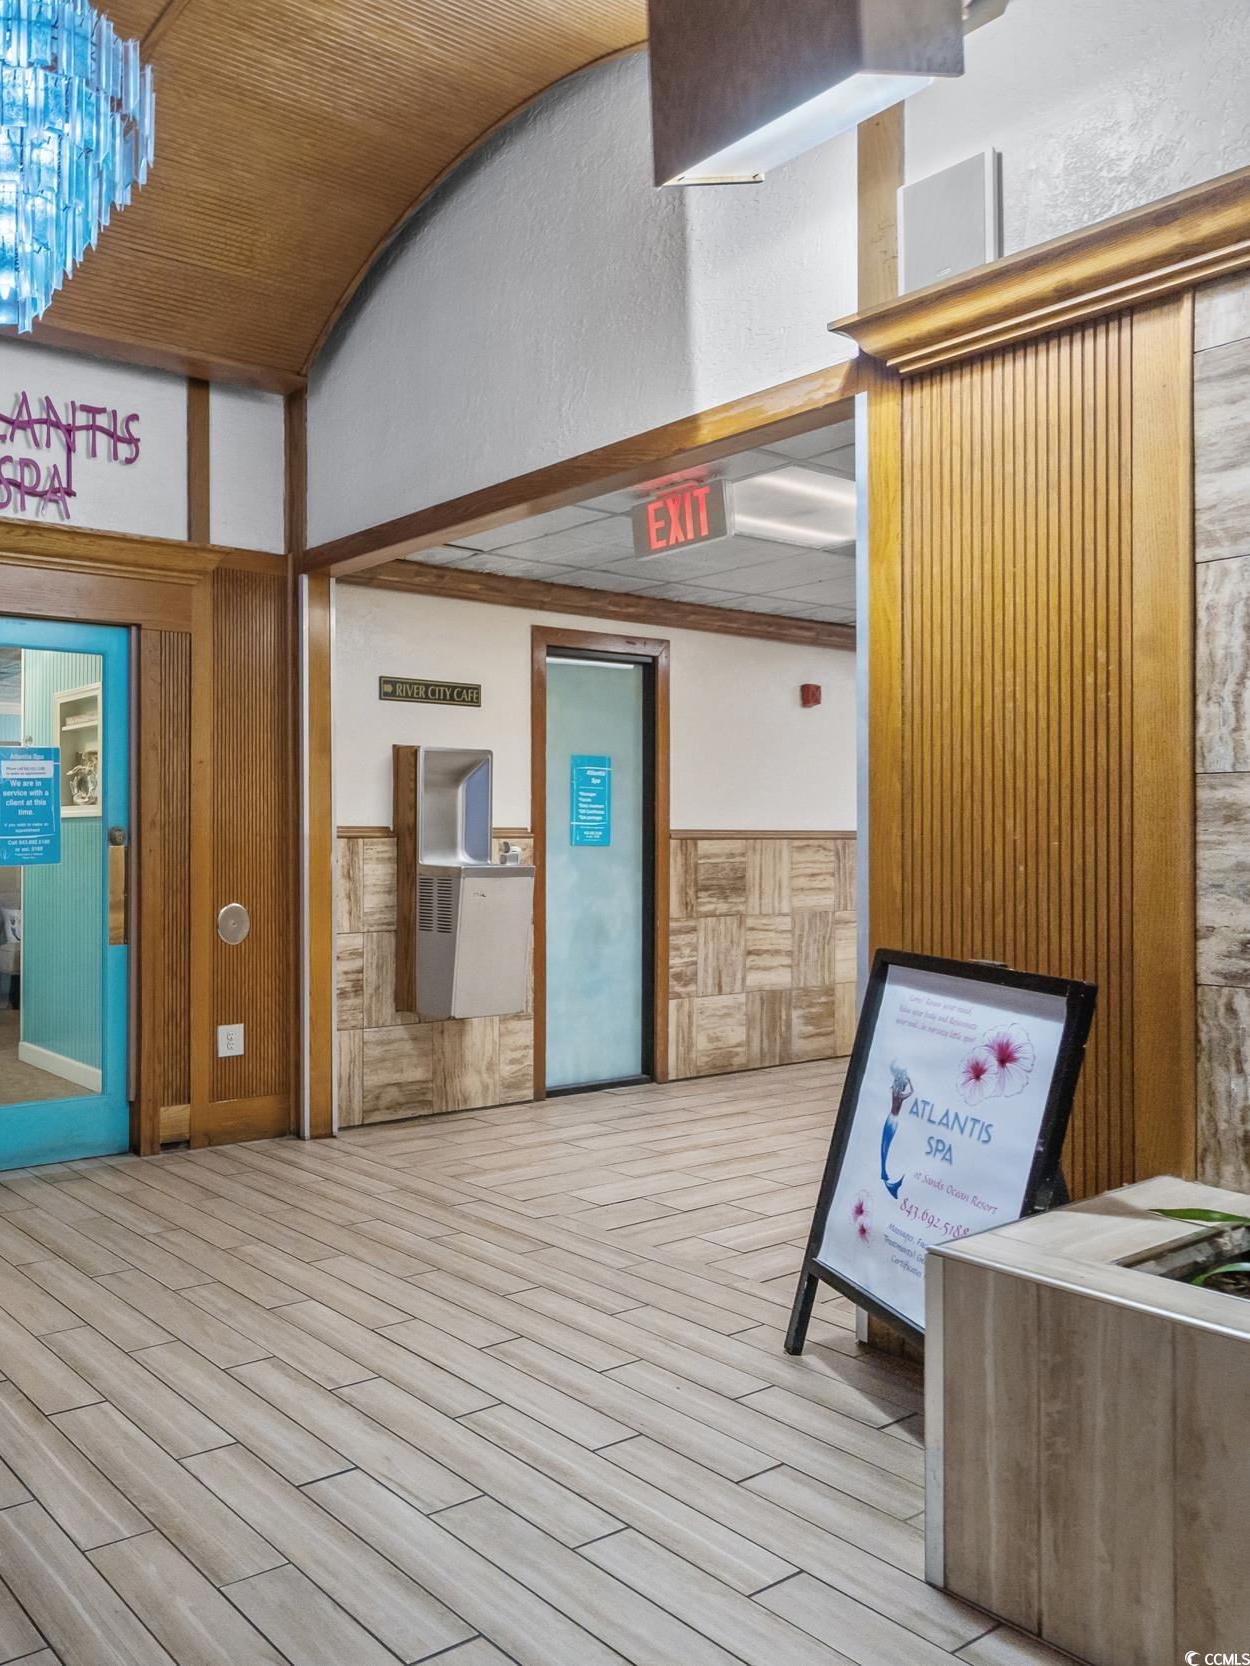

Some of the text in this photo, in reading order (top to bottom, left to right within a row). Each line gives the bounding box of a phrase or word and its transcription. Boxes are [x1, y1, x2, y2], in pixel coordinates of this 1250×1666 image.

[647, 486, 711, 550] EXIT
[396, 684, 479, 702] RIVER CITY CAFE
[909, 1097, 994, 1144] ATLANTIS
[925, 1136, 953, 1165] SPA
[922, 1174, 945, 1191] Sands
[946, 1184, 969, 1202] Ocean
[970, 1195, 999, 1215] Resort
